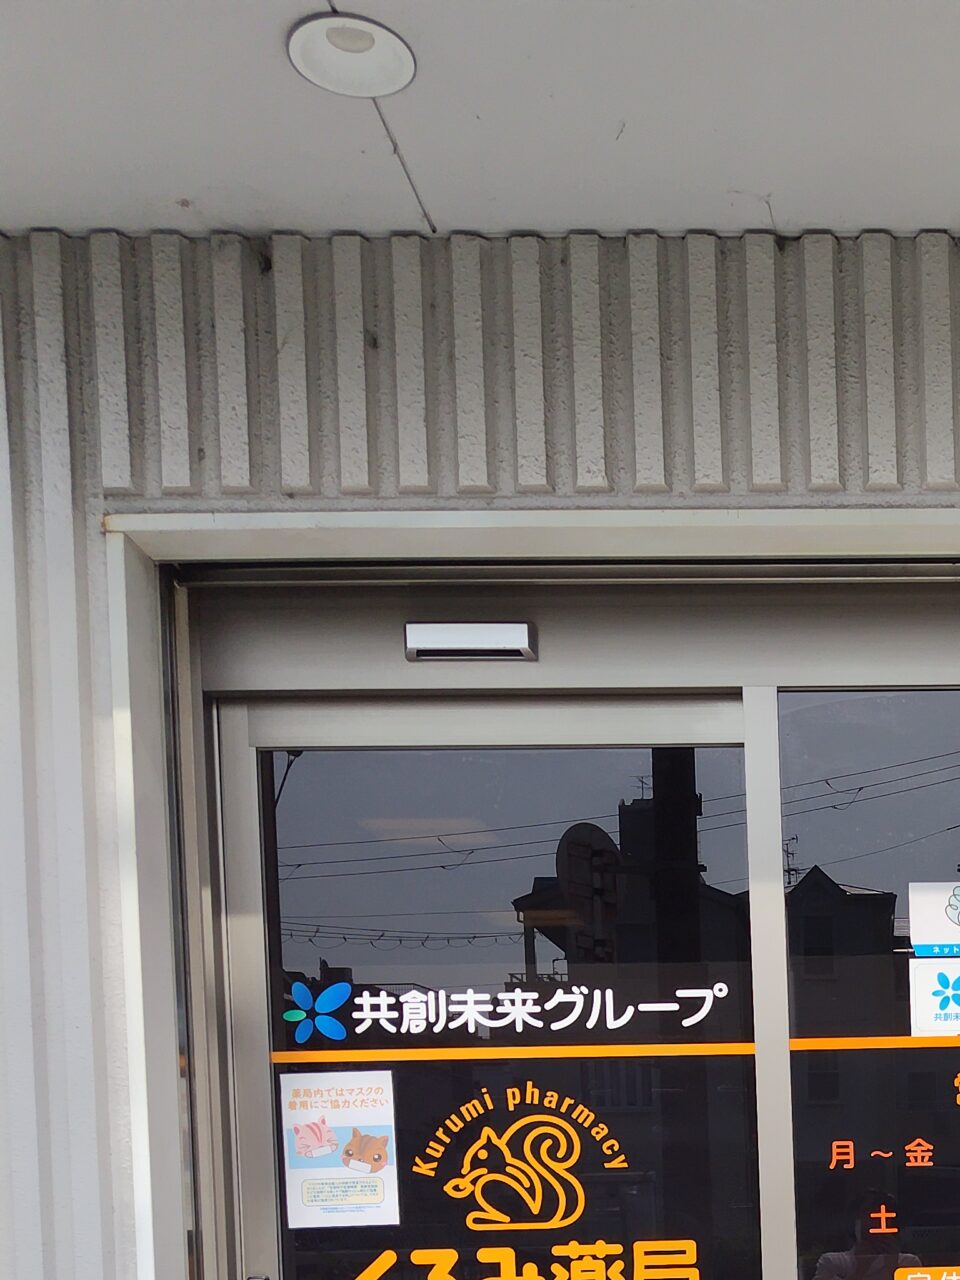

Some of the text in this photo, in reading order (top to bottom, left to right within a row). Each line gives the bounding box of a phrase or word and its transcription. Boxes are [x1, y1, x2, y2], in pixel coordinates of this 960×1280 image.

[352, 982, 729, 1035] 共創未来グループ
[411, 1080, 629, 1178] Kurumi pharmacy
[868, 1204, 899, 1235] 土
